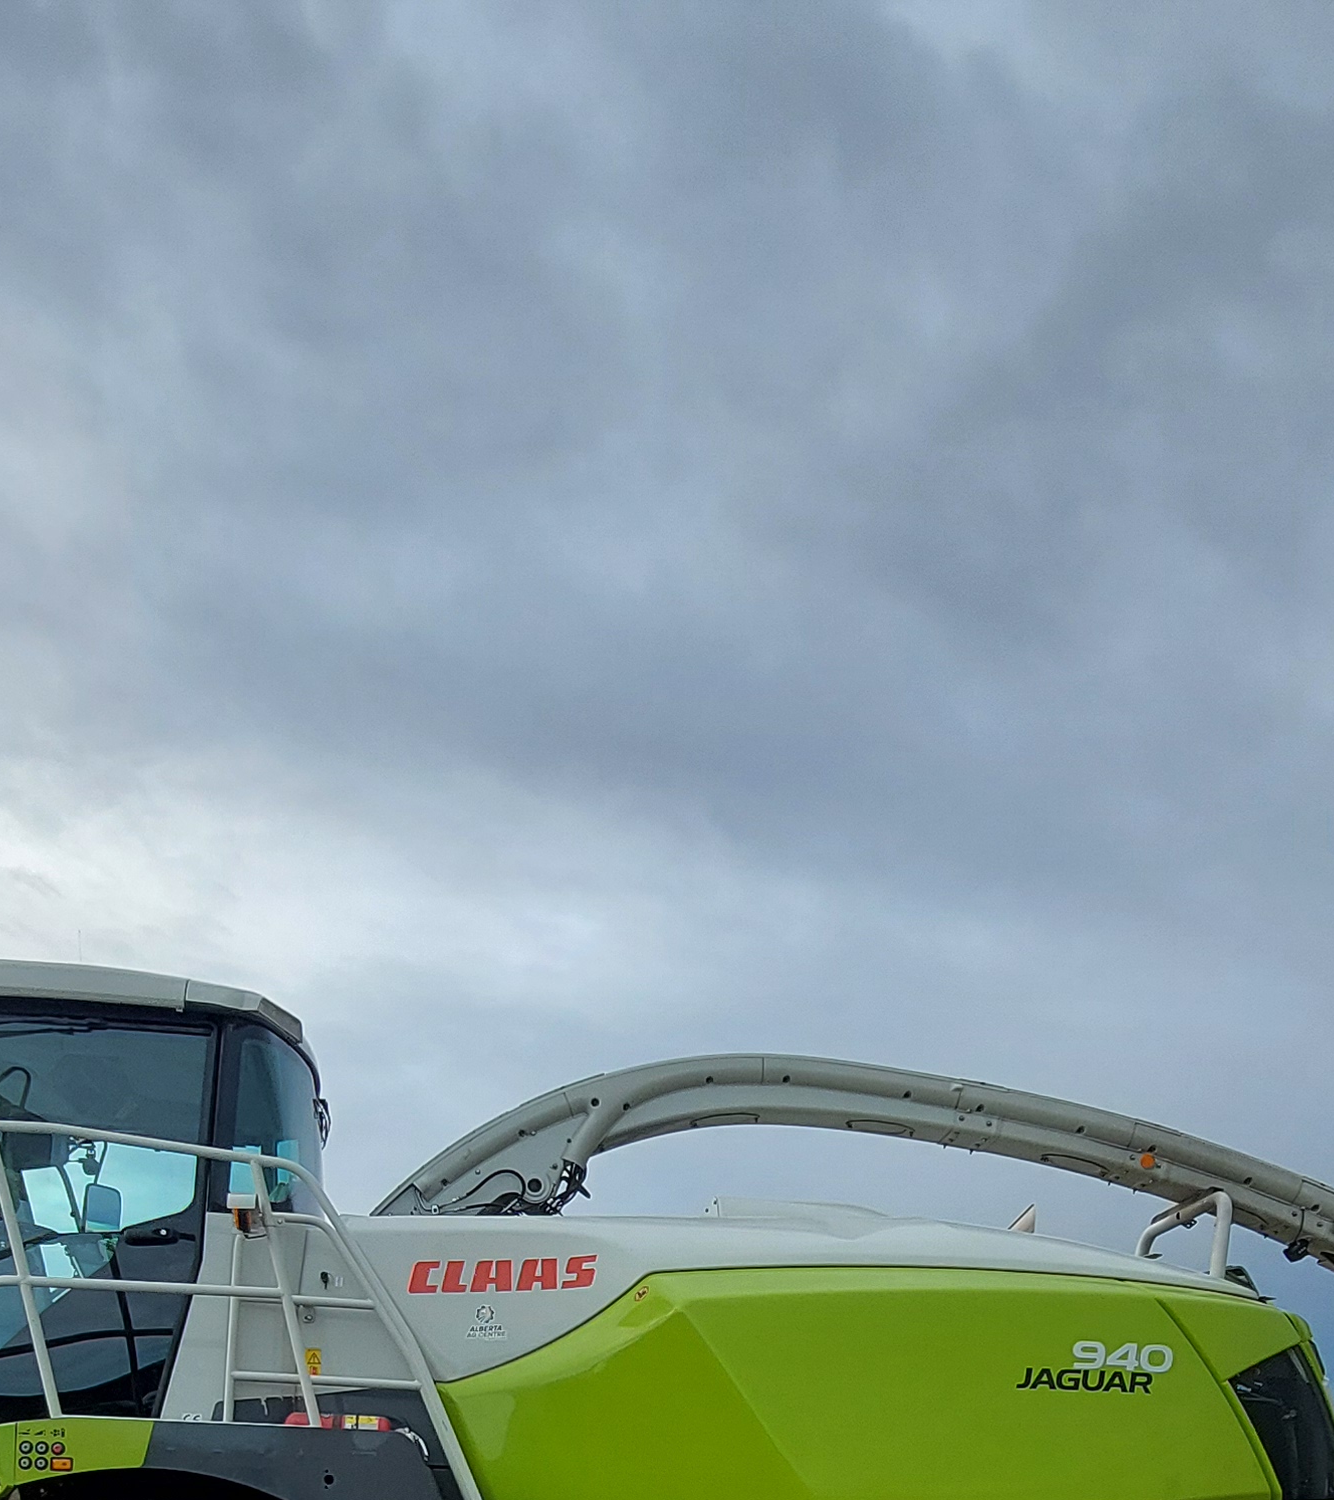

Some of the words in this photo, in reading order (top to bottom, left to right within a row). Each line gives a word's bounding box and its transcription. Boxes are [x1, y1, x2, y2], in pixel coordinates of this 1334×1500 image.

[408, 1254, 598, 1294] CLAAS
[469, 1324, 503, 1332] ALBERTA
[1072, 1340, 1174, 1374] 940
[1015, 1367, 1154, 1395] JAGUAR
